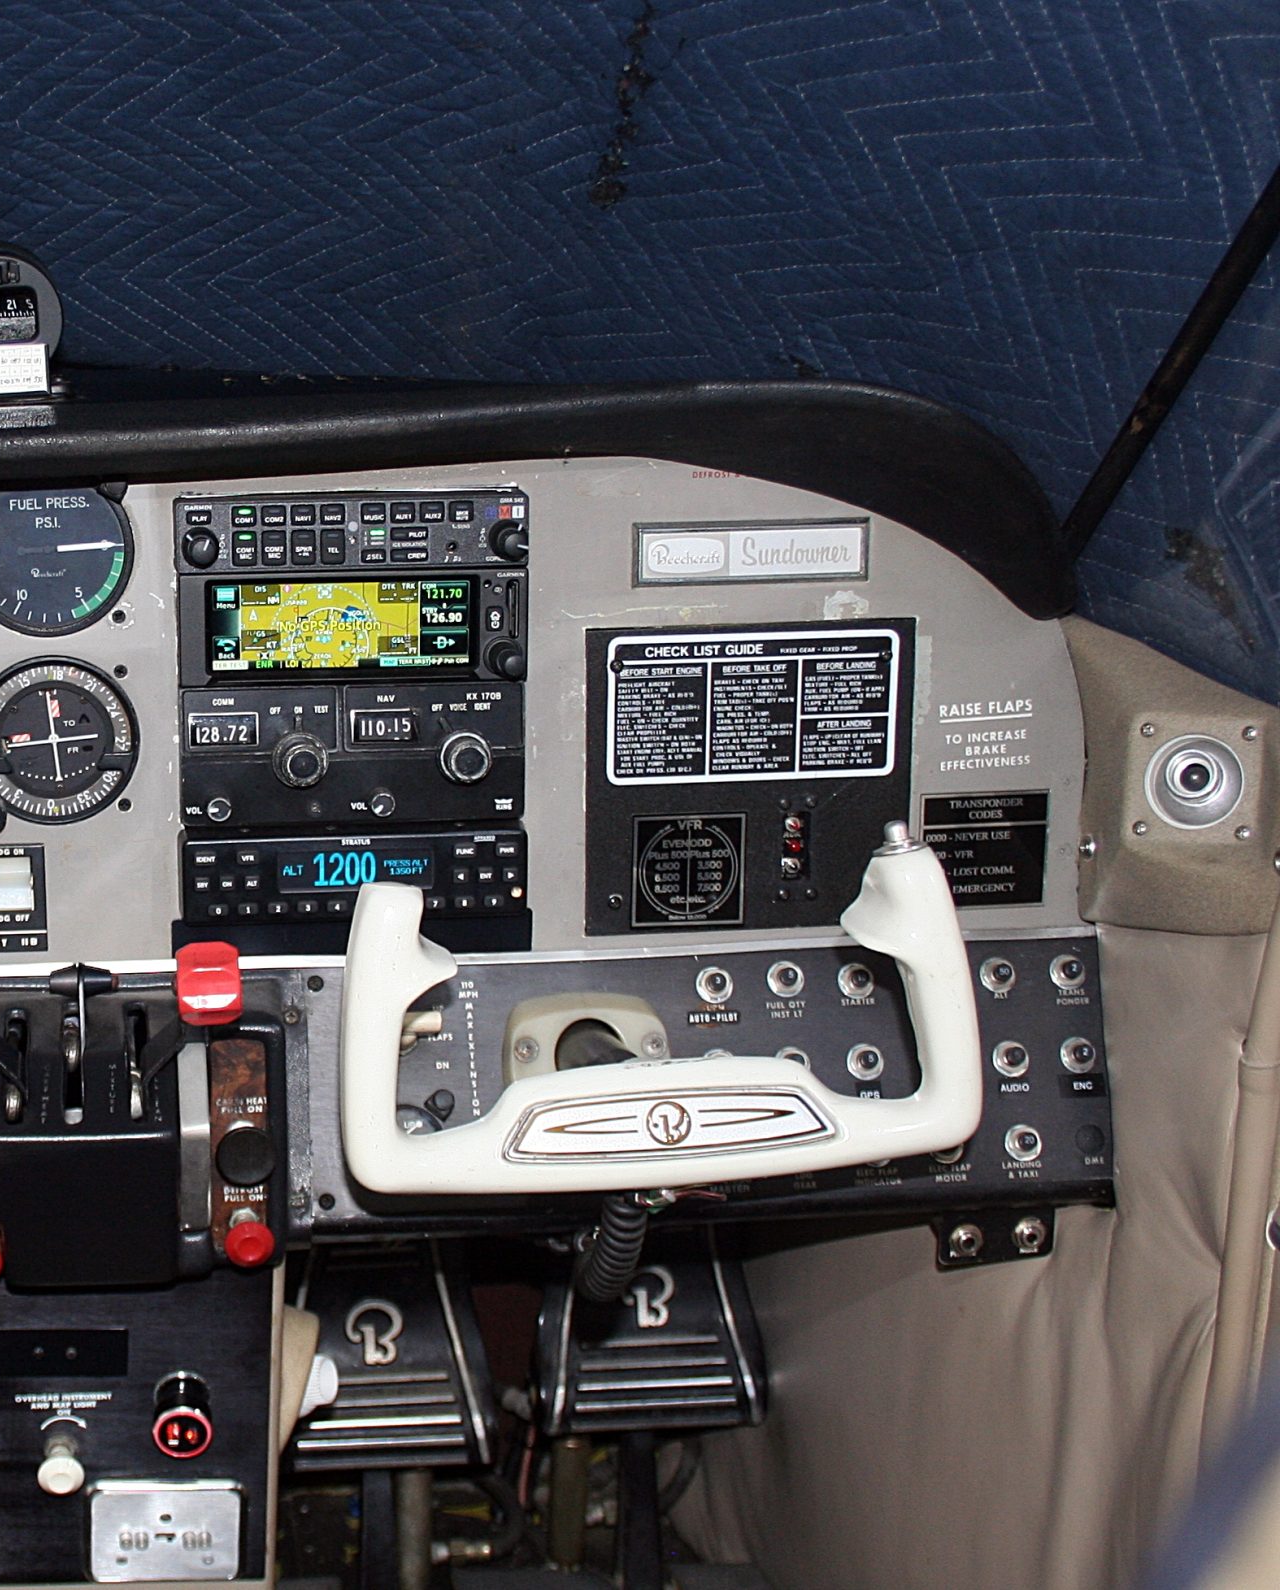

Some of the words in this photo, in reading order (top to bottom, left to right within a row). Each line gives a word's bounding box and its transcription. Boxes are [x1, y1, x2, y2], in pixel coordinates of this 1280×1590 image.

[7, 300, 17, 310] 21
[26, 299, 33, 309] S
[10, 499, 42, 511] FUEL
[46, 497, 89, 509] PRESS.
[653, 544, 721, 565] Beechcraft
[742, 537, 851, 566] Sundowner
[427, 589, 462, 599] 121.70
[426, 613, 462, 623] 126.90
[280, 622, 296, 631] No
[301, 621, 326, 631] GPS
[330, 620, 380, 631] Position
[645, 646, 690, 658] CHECK
[694, 645, 720, 656] LIST
[725, 644, 763, 655] GUIDE
[846, 661, 877, 669] LANDING
[620, 668, 648, 676] BEFORE
[676, 667, 702, 675] ENGINE
[939, 703, 981, 717] RAISE
[989, 699, 1033, 713] FLAPS
[361, 718, 411, 736] 110.15
[196, 725, 247, 743] 128.72
[946, 734, 962, 744] TO
[968, 730, 1027, 742] INCREASE
[966, 744, 1007, 756] BRAKE
[941, 756, 1030, 771] EFFECTIVENESS
[351, 802, 367, 810] VOL
[950, 799, 1023, 809] TRANSPONDER
[969, 810, 1003, 819] CODES
[677, 820, 703, 830] VFR
[342, 838, 371, 846] STRATUS
[926, 834, 946, 842] 0000
[954, 833, 989, 841] NEVER
[991, 832, 1010, 840] USE
[954, 850, 974, 858] VFR
[283, 865, 303, 876] ALT
[313, 852, 376, 886] 1200
[954, 868, 977, 876] LOST
[953, 884, 1015, 893] EMERGENCY
[841, 998, 875, 1006] STARTER
[689, 1013, 738, 1023] AUTO-PILOT
[1001, 1084, 1029, 1092] AUDIO
[1073, 1082, 1092, 1090] ENC
[1002, 1161, 1042, 1169] LANDING
[1085, 1157, 1104, 1165] DME
[936, 1174, 967, 1182] MOTOR
[15, 1394, 59, 1402] OVERHEAD
[62, 1392, 112, 1401] INSTRUMENT
